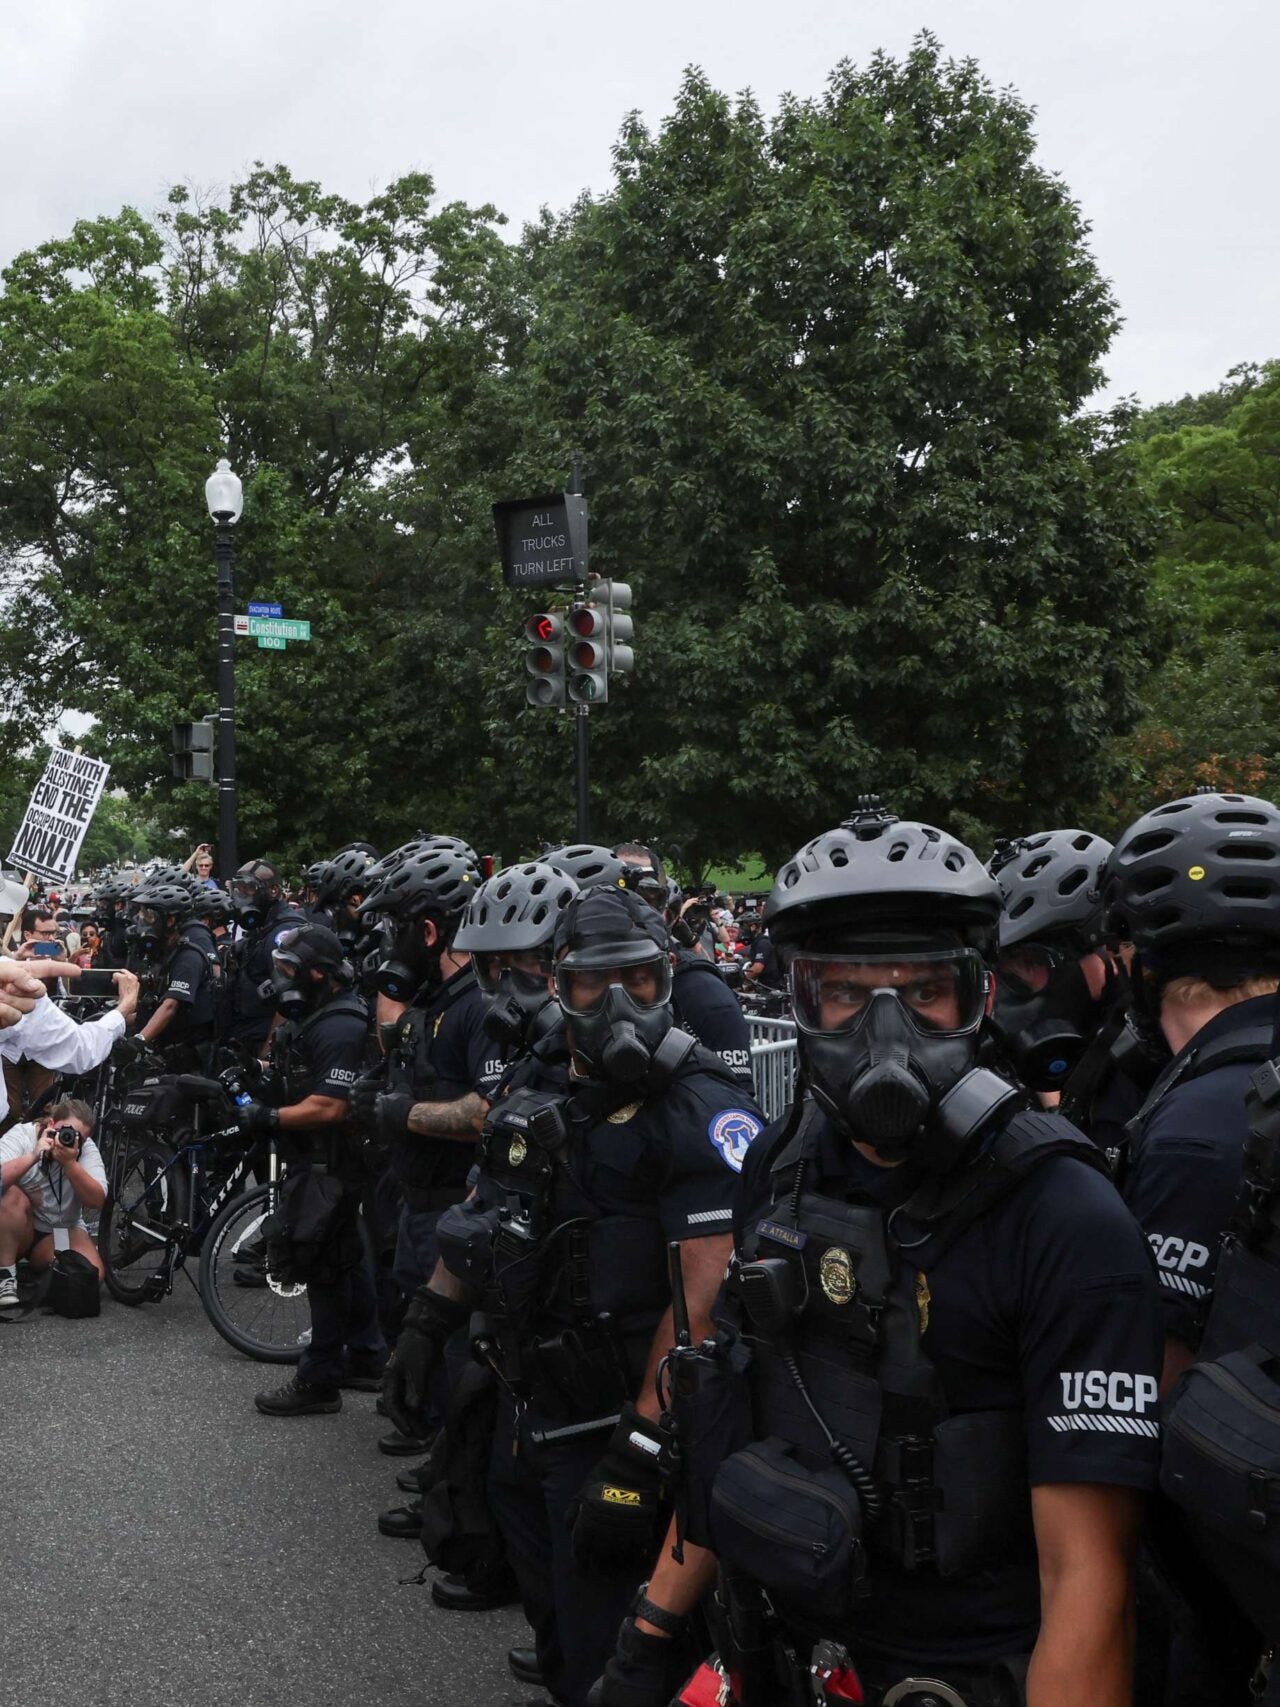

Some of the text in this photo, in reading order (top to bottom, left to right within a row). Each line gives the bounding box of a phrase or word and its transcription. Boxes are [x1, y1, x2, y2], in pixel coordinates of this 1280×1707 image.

[532, 513, 554, 527] ALL
[521, 534, 566, 552] TRUCKS
[513, 557, 574, 577] TURN LEFT
[251, 620, 298, 637] Constitution
[263, 638, 280, 647] 100
[72, 757, 105, 782] WITH
[44, 766, 99, 799] PALESTINE!
[33, 782, 94, 823] END THE
[26, 807, 82, 841] OCCUPATION
[14, 822, 75, 872] NOW!
[171, 980, 190, 989] USCP
[125, 1104, 146, 1115] POLICE
[770, 1226, 800, 1246] ATTALLA
[1146, 1233, 1210, 1273] SCP
[1059, 1370, 1159, 1413] USCP
